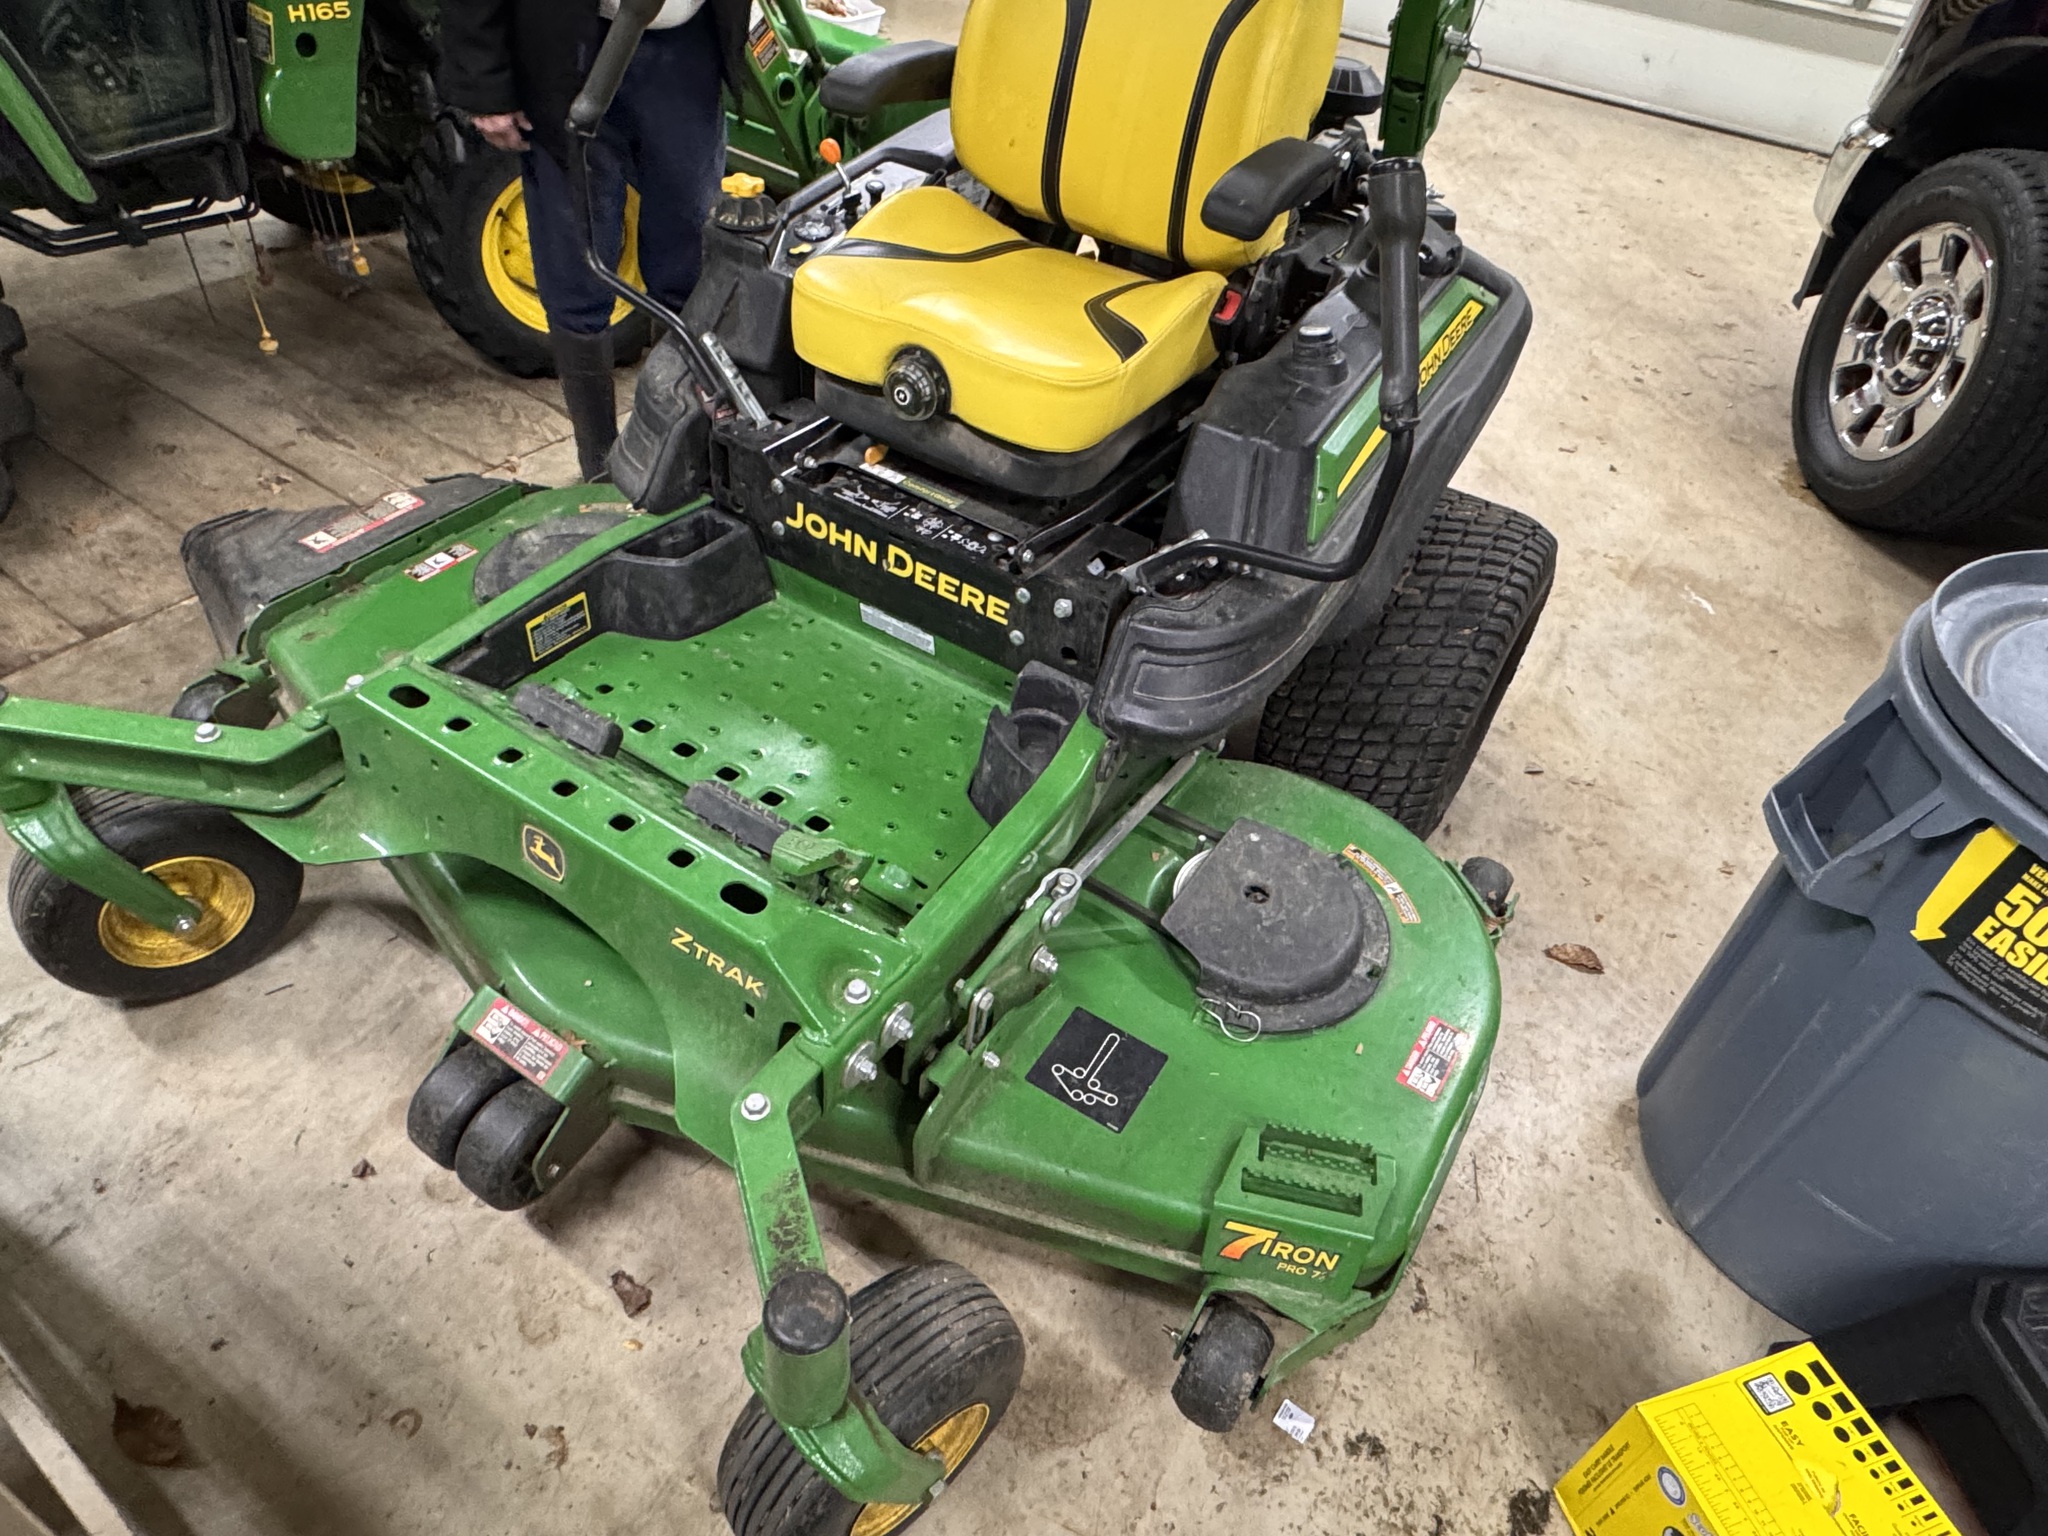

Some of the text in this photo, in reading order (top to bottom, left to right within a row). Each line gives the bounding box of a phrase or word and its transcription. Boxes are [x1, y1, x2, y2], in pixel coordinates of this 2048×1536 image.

[287, 1, 351, 23] H165
[1418, 306, 1474, 387] OHN DEERE
[786, 502, 1010, 626] JOHN DEERE
[671, 927, 764, 998] ZTRAK
[1276, 1262, 1307, 1276] PRO
[1781, 1420, 1805, 1446] EASY
